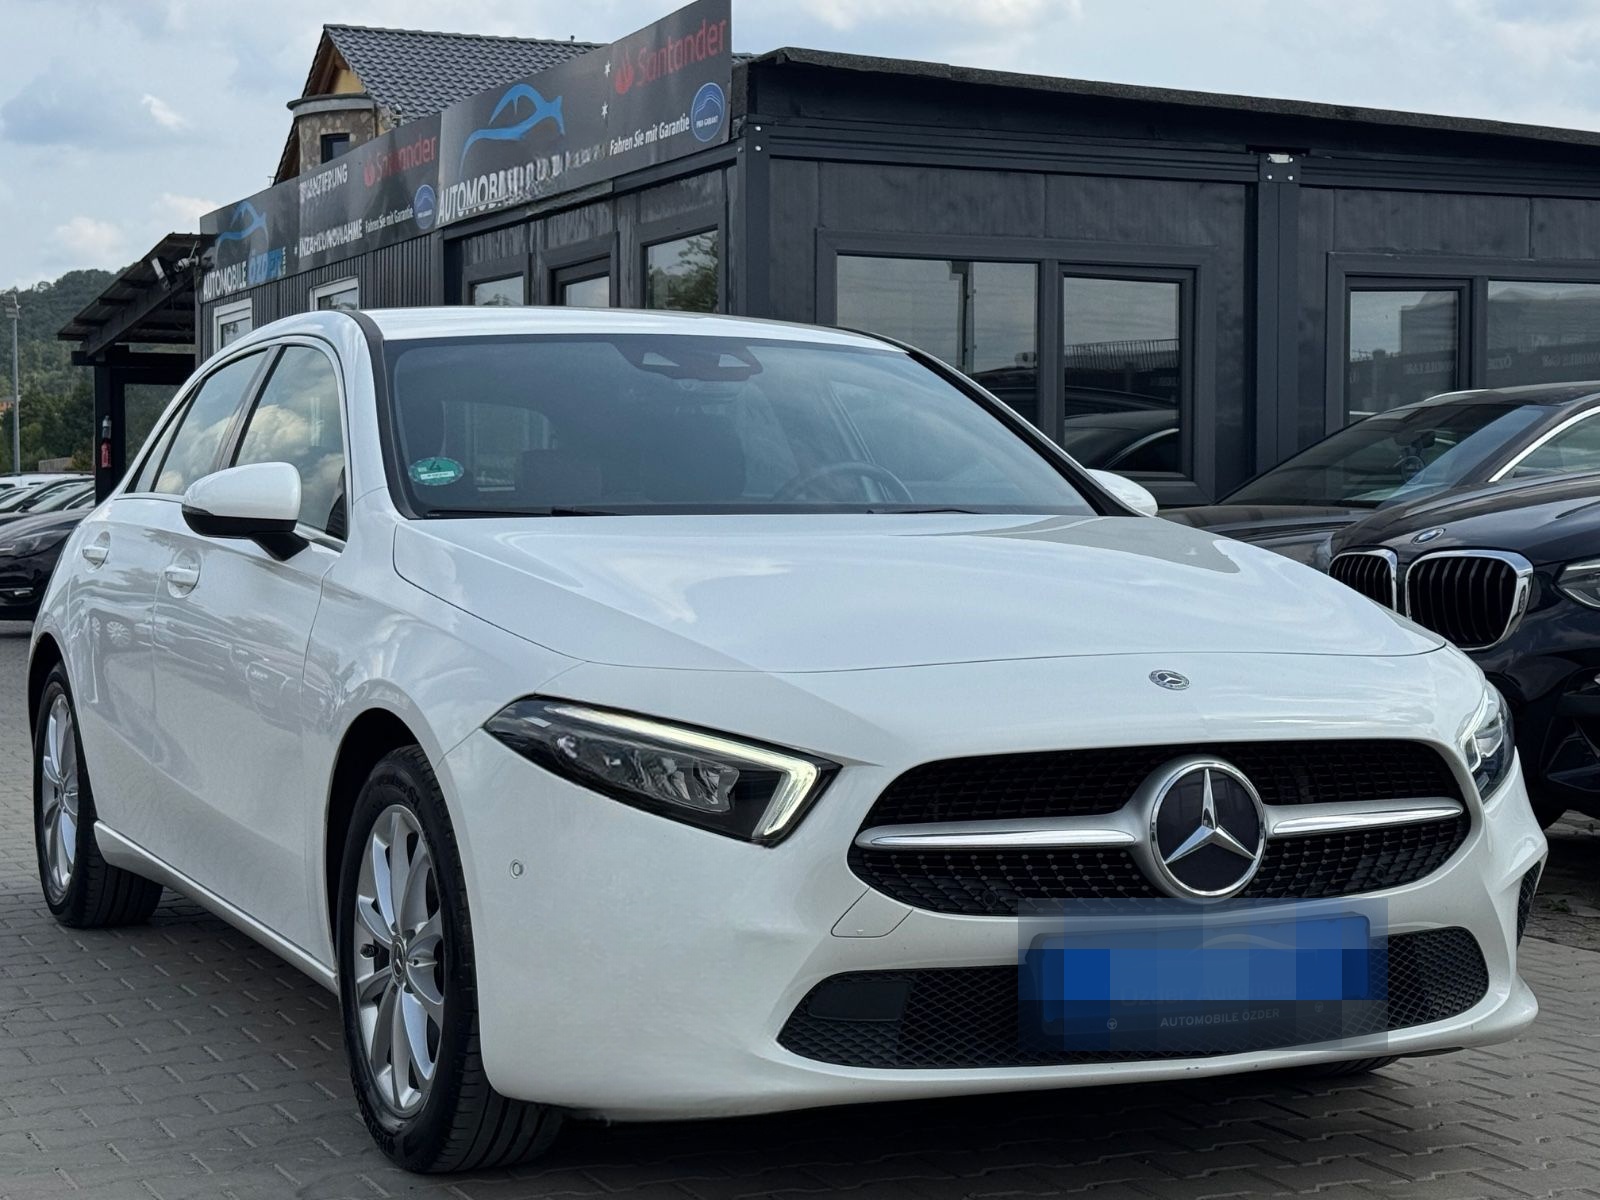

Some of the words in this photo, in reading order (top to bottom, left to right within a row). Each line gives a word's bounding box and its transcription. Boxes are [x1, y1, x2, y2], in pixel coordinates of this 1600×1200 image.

[637, 19, 727, 87] Santander
[610, 137, 633, 156] Fahren
[633, 129, 644, 148] Sie
[645, 124, 658, 144] mit
[659, 113, 690, 140] Garantie
[376, 136, 437, 182] Saander
[203, 260, 247, 302] AUTOMOBILE
[1160, 1012, 1239, 1028] AUTOMOBILE
[1242, 1008, 1280, 1021] ÖZDER
